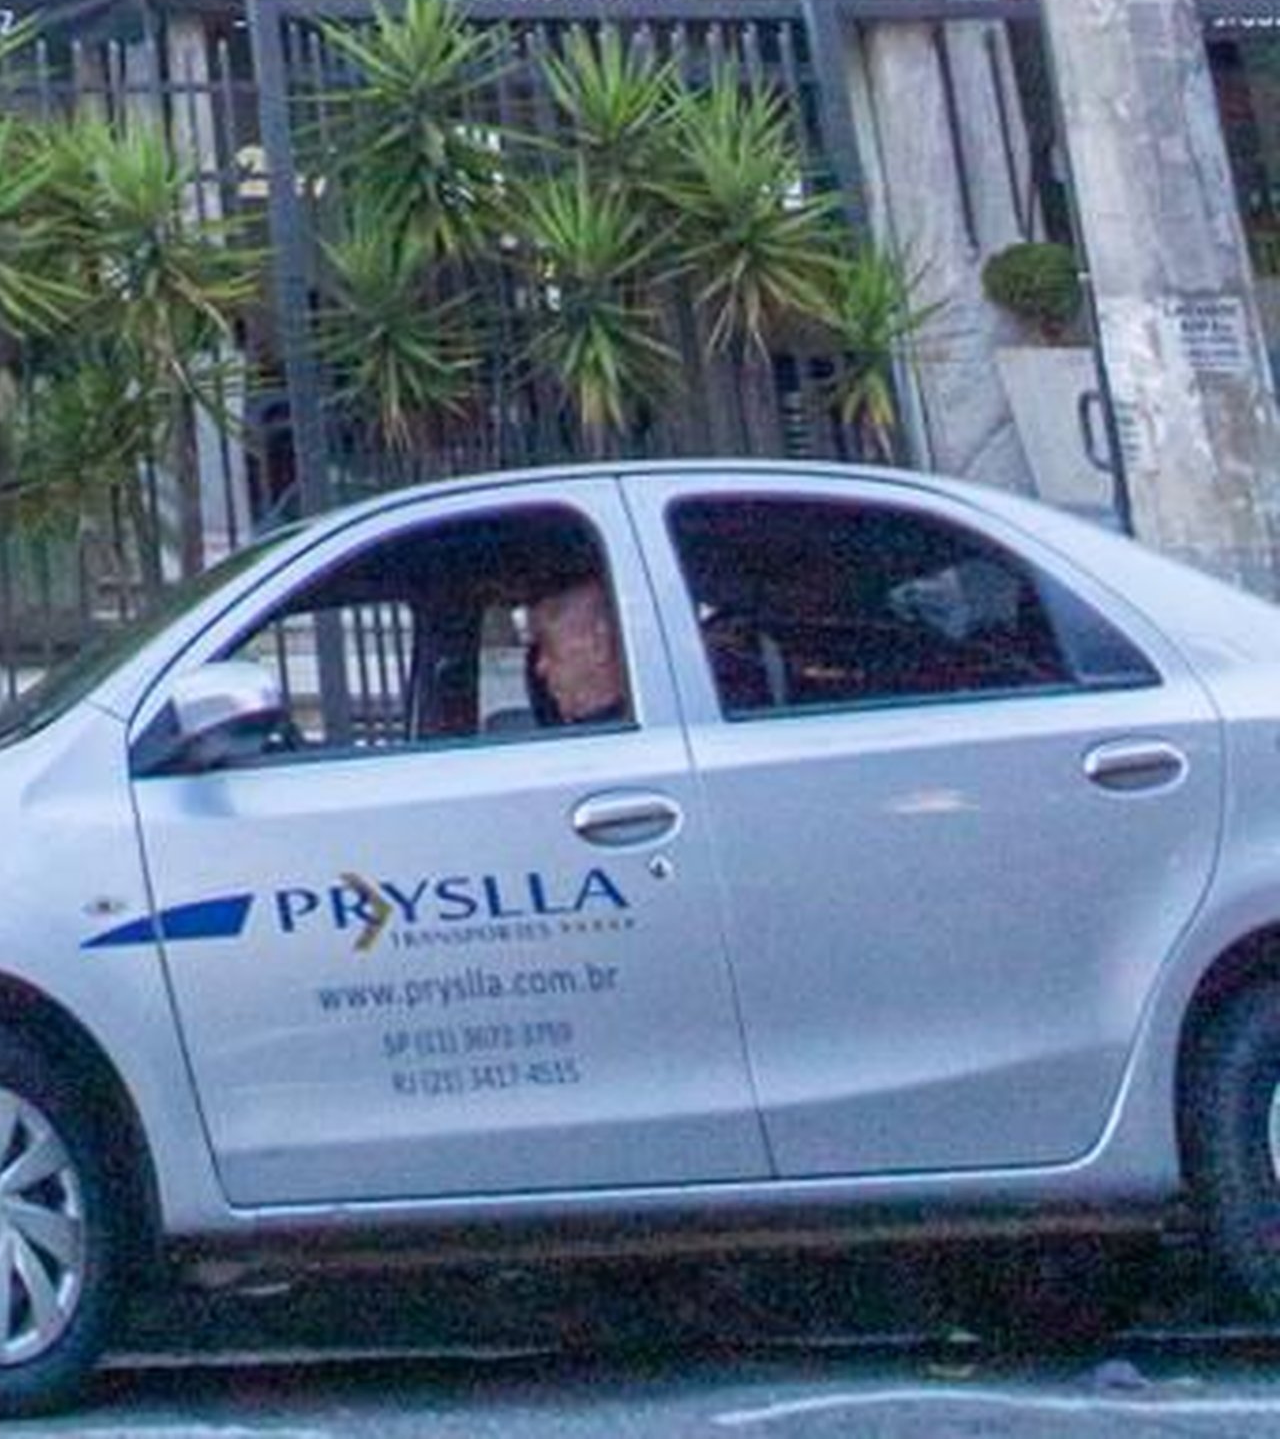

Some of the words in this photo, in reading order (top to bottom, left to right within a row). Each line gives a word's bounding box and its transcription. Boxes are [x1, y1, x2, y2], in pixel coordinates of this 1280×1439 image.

[274, 867, 632, 933] PRYSLLA
[390, 920, 552, 950] TRANSPORTES
[317, 962, 619, 1013] www.pryslla.com.br
